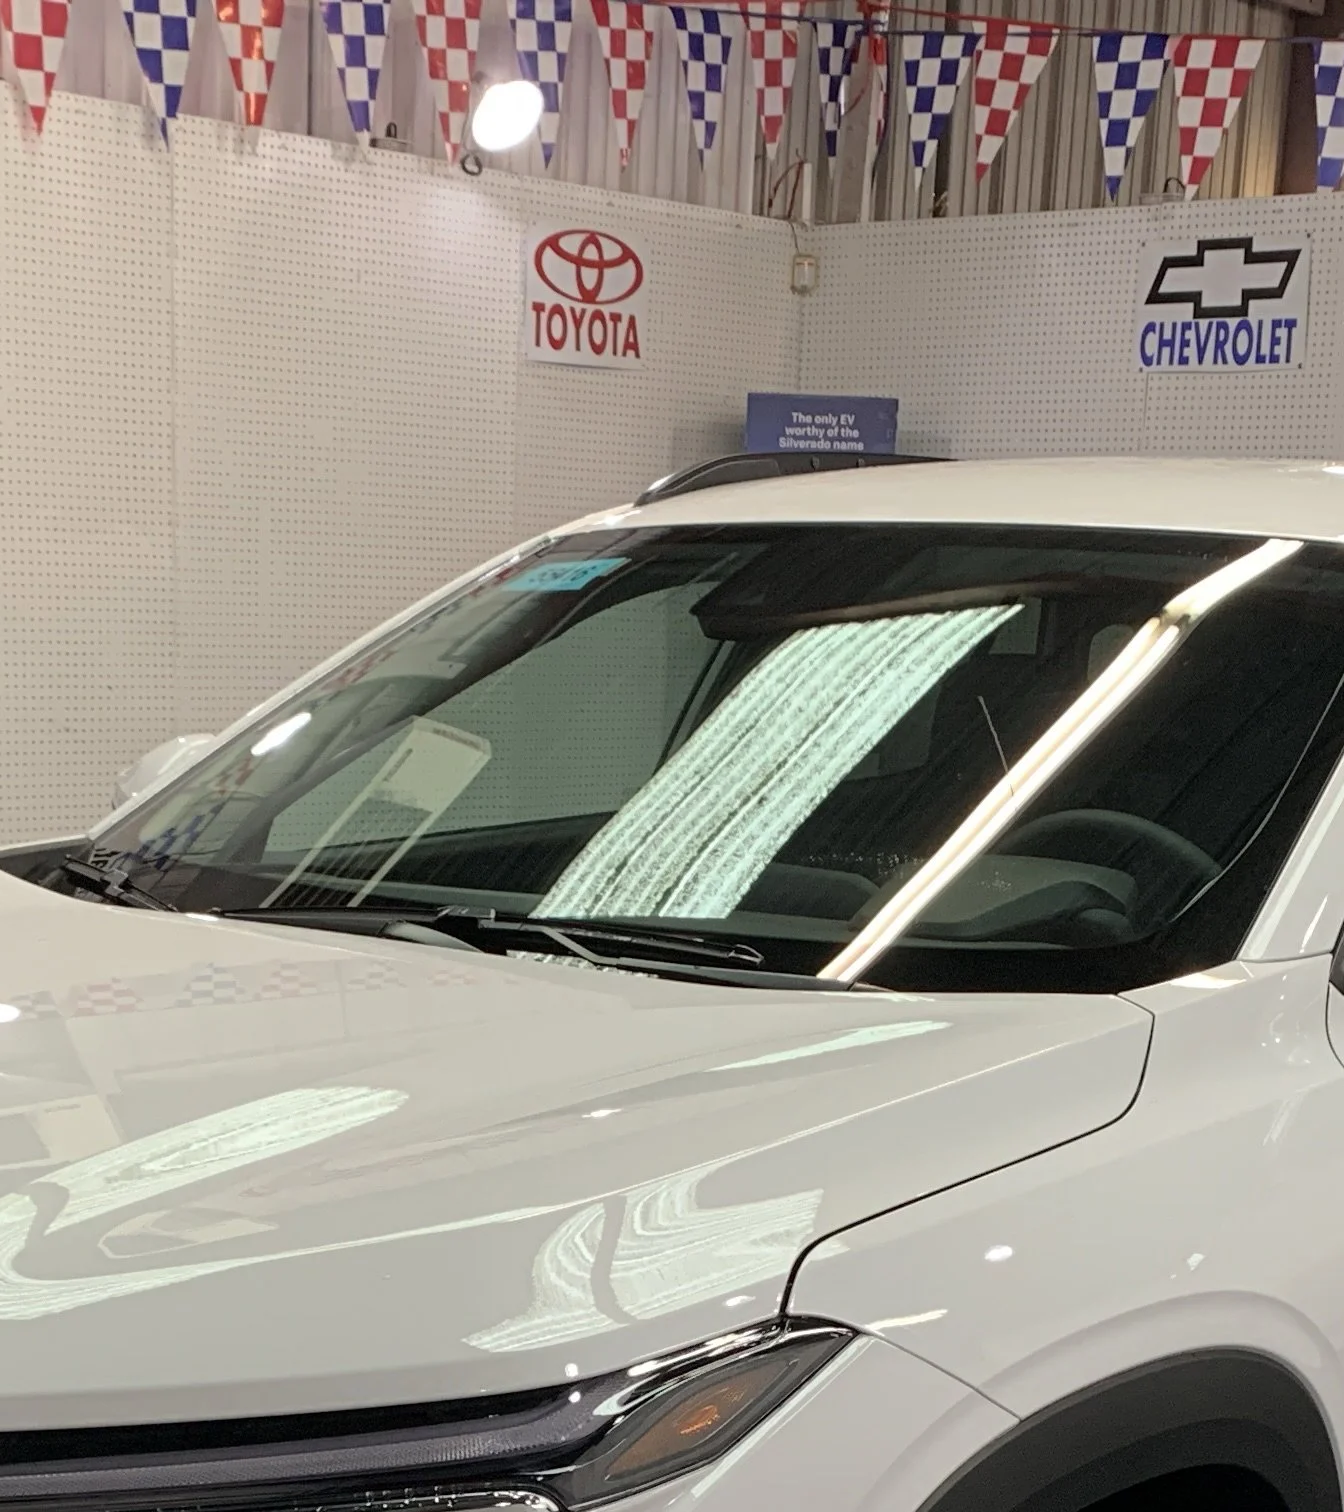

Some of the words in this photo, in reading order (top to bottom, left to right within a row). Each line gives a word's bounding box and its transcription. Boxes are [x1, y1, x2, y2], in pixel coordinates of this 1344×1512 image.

[532, 302, 641, 359] TOYOTA
[1140, 318, 1297, 367] CHEVROLET
[792, 412, 812, 423] The
[814, 413, 838, 426] only
[840, 414, 855, 425] EV
[785, 425, 825, 438] worthy
[827, 426, 838, 437] of
[841, 426, 860, 438] the
[778, 437, 831, 449] Silverado
[833, 440, 864, 451] name
